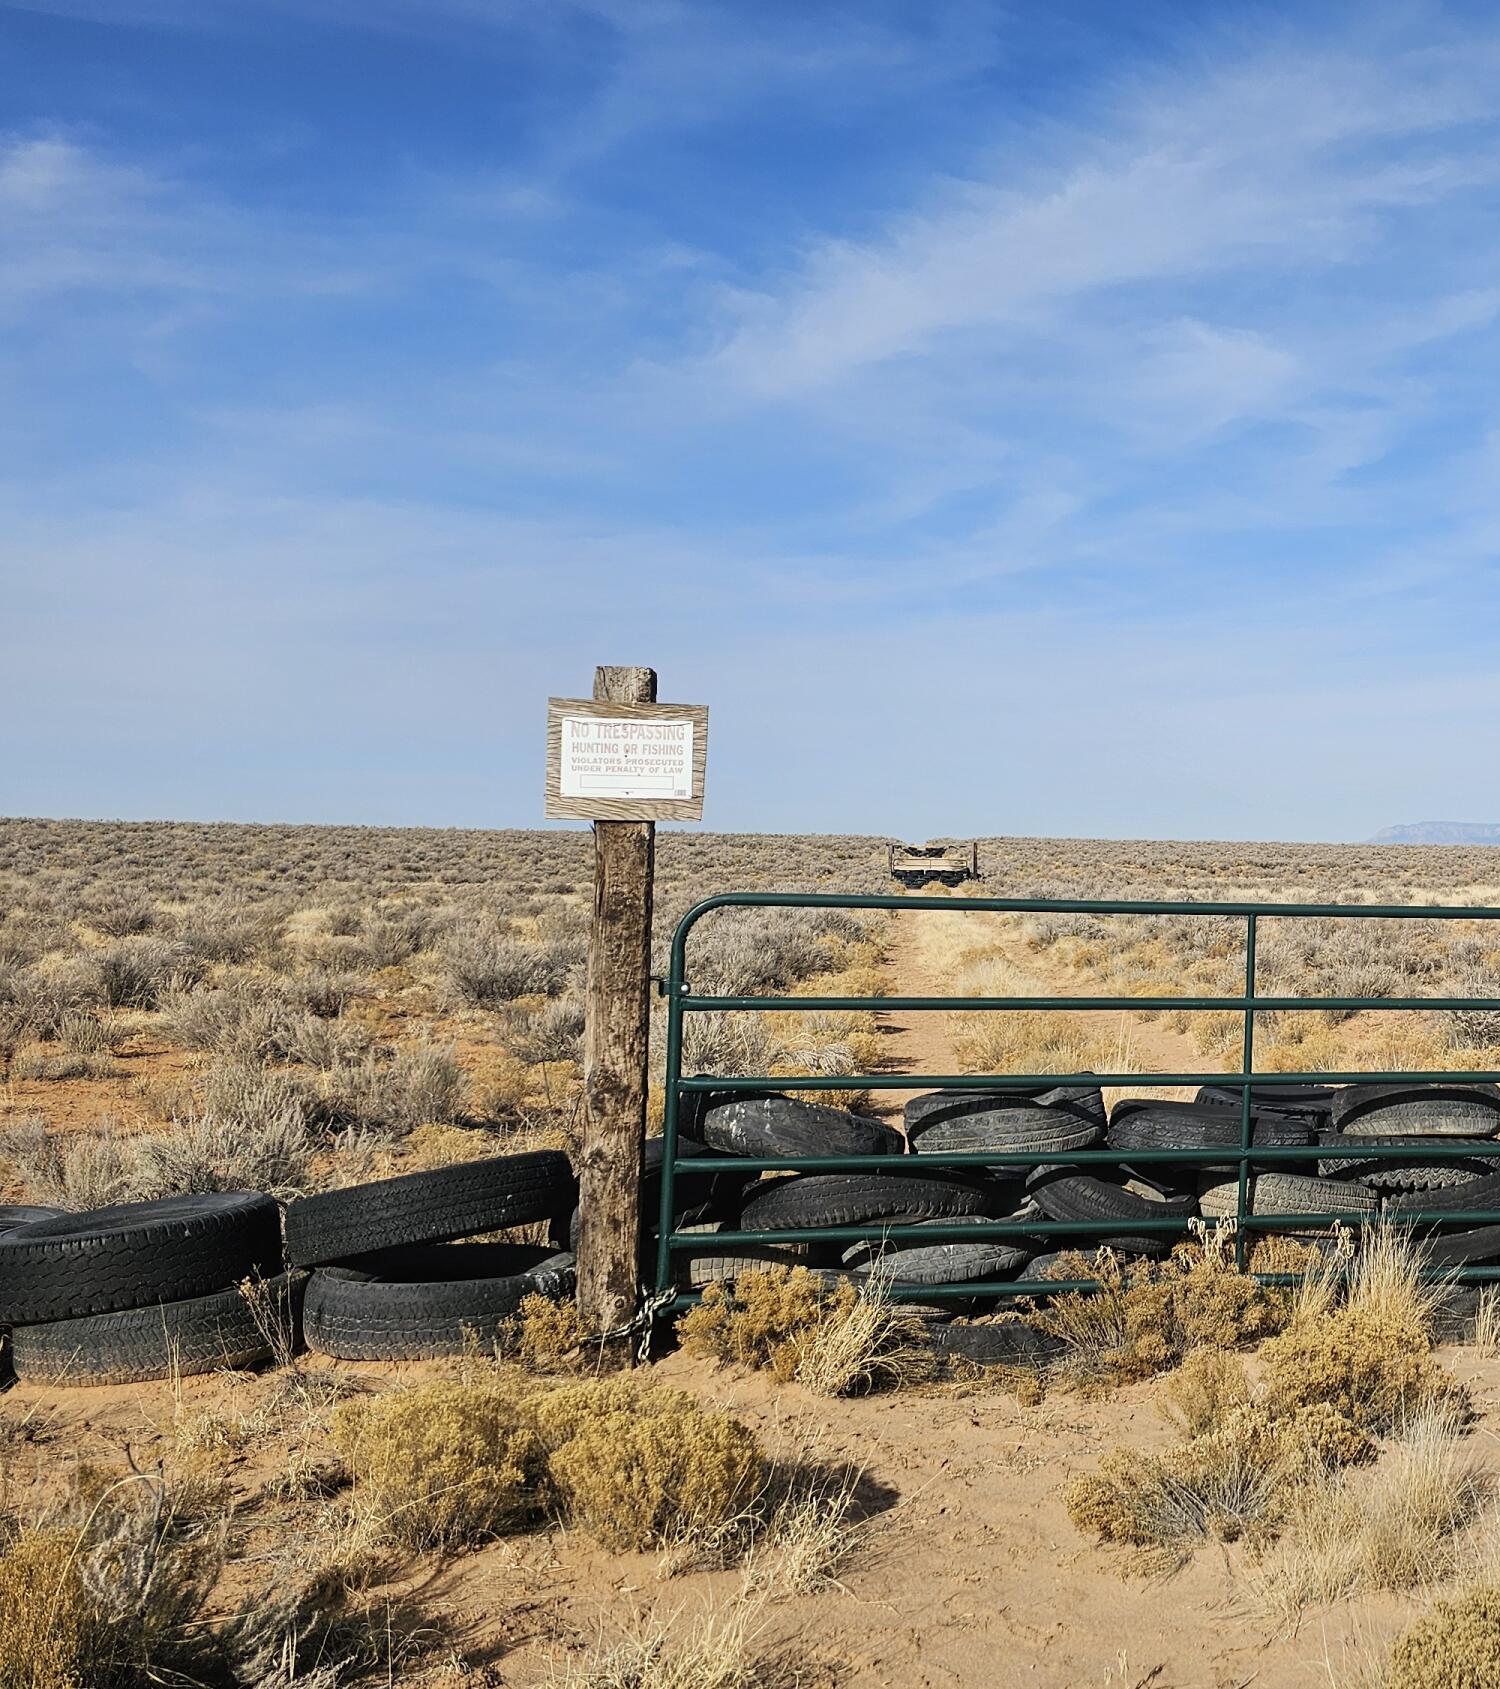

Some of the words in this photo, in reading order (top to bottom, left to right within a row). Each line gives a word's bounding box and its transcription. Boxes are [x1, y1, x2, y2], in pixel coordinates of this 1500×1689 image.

[571, 722, 590, 738] NO
[597, 724, 685, 741] TRESPASSING
[572, 742, 619, 754] HUNTING
[623, 743, 638, 755] OR
[642, 744, 684, 756] FISHING
[571, 757, 622, 765] VIOLATORS
[625, 758, 684, 767] PROSECUTED
[605, 765, 645, 774] PENALTY
[648, 766, 659, 774] OF
[663, 767, 684, 775] LAW
